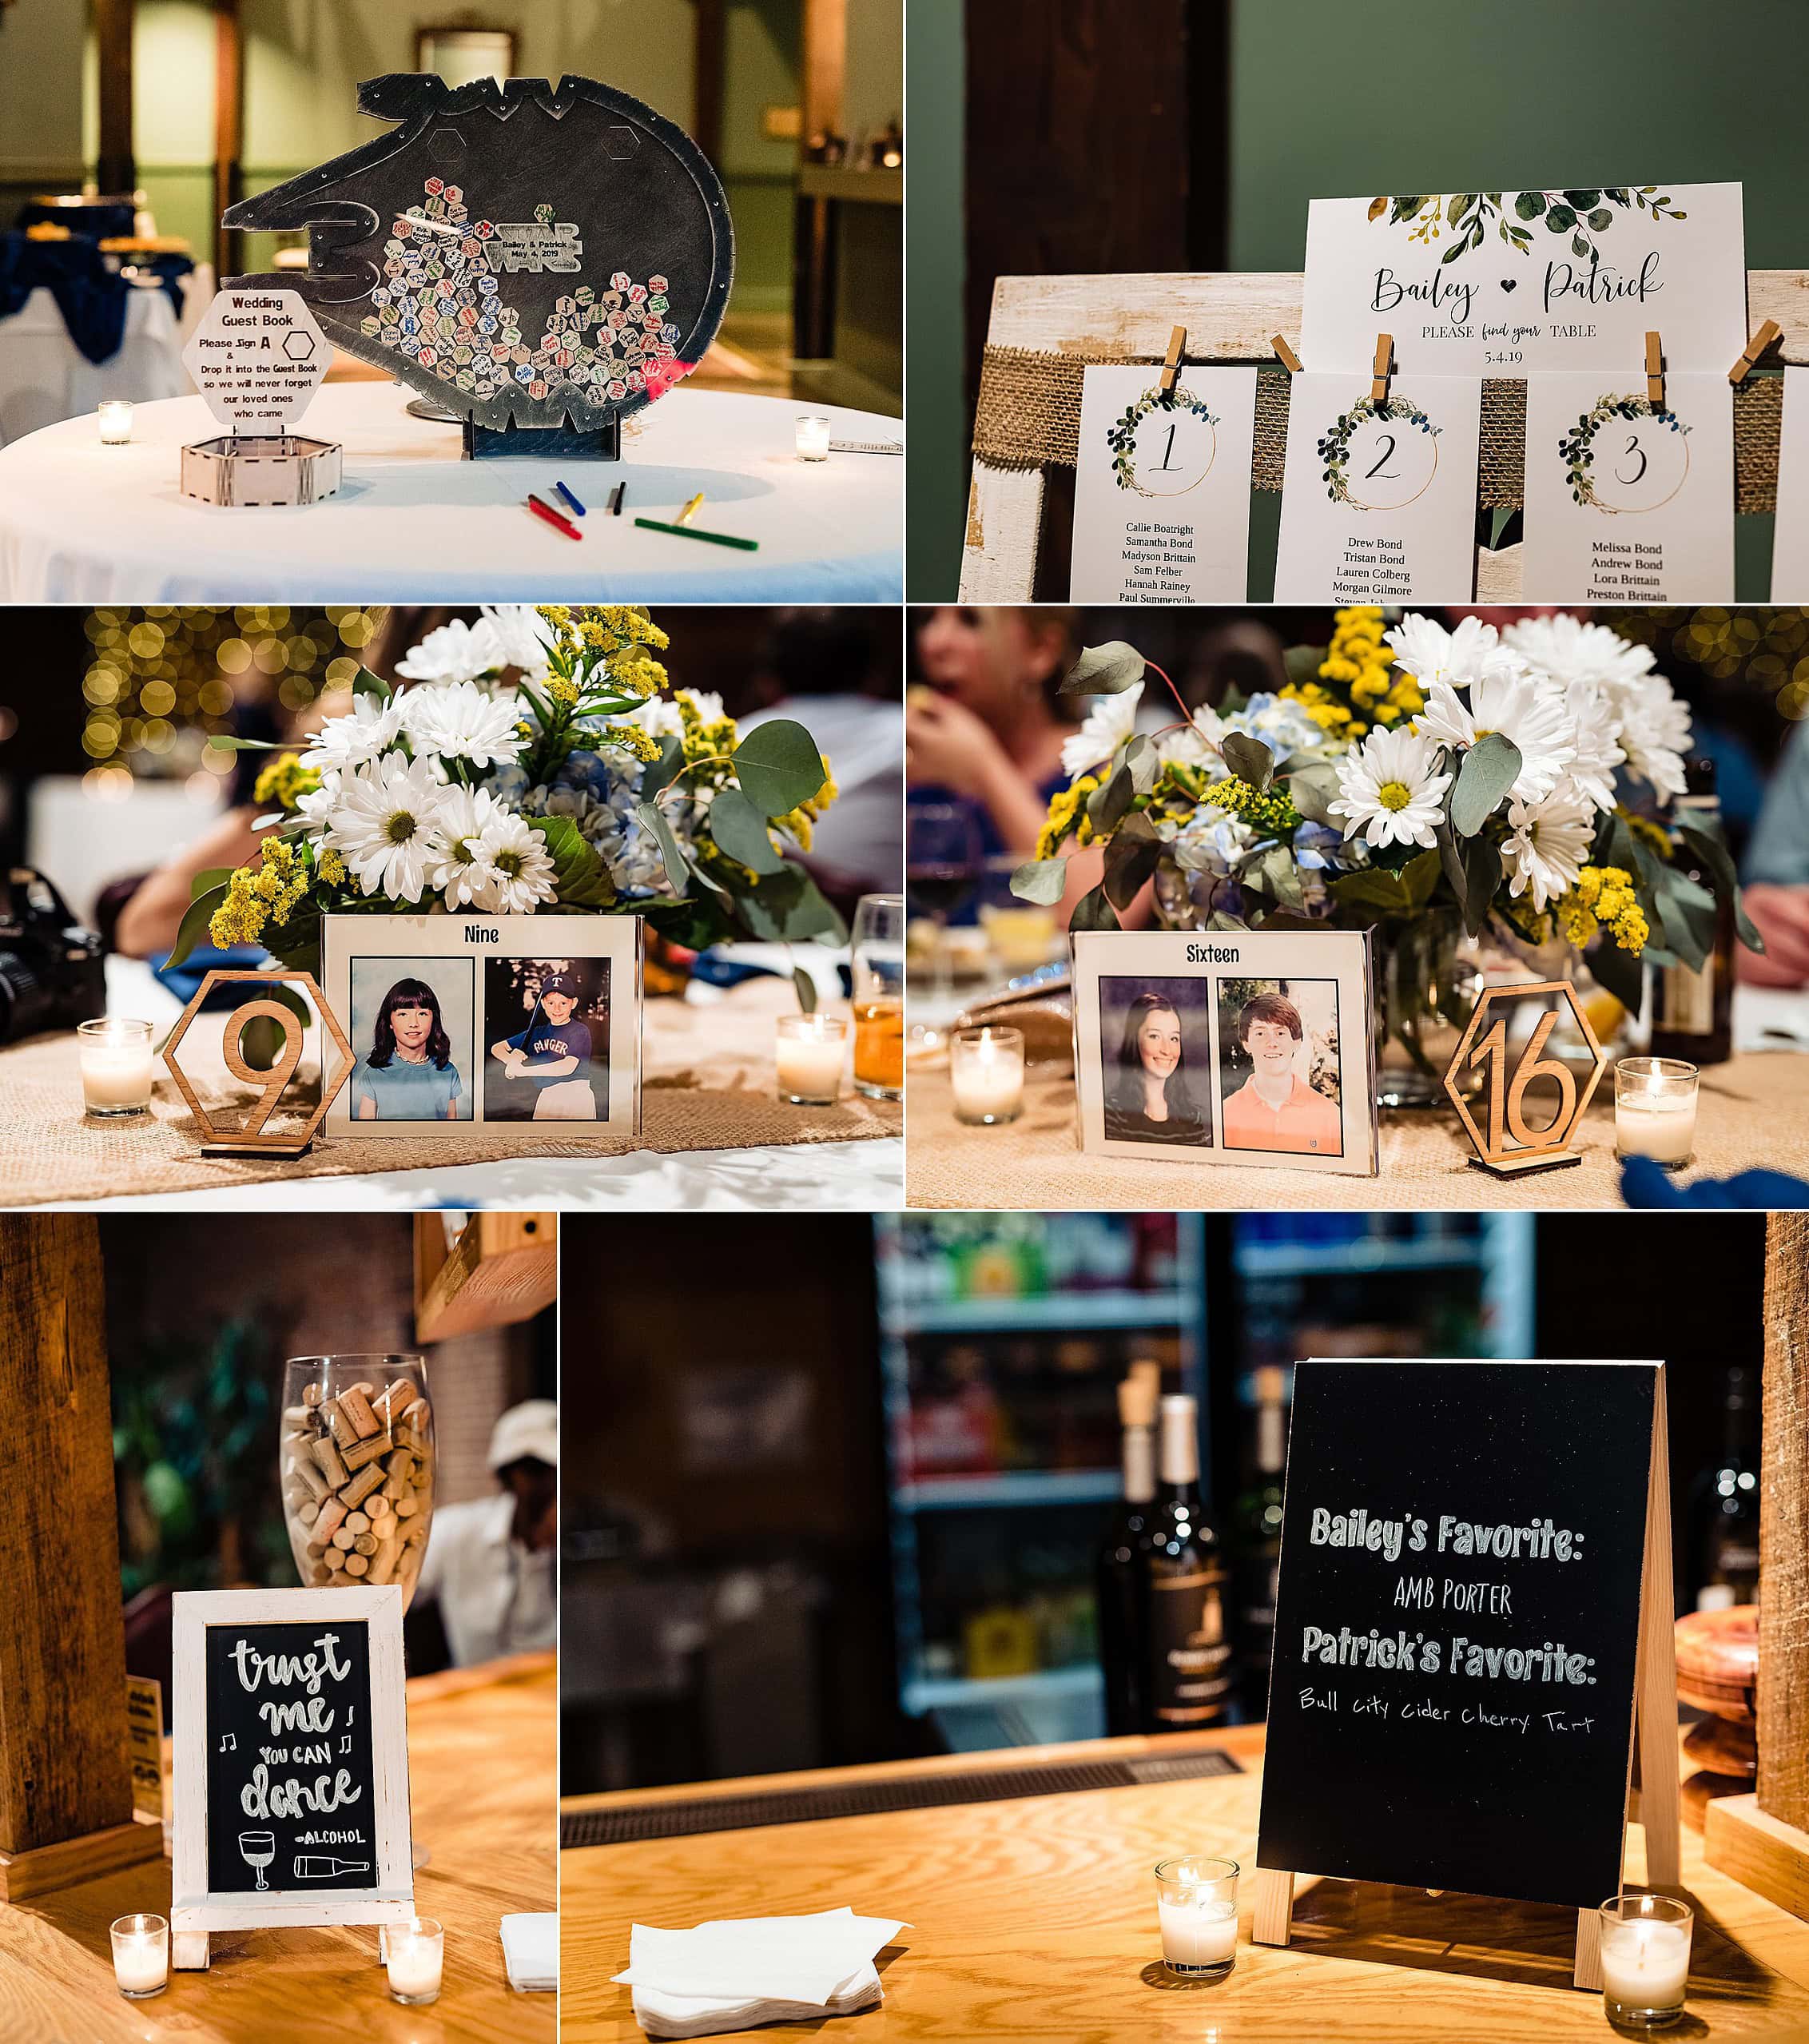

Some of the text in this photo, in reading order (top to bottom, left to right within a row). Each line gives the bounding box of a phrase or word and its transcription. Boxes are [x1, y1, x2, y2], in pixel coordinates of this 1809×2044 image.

[1370, 251, 1664, 324] Bailey Patrick
[232, 297, 283, 311] Wedding
[222, 315, 293, 326] Guest Book
[1421, 323, 1596, 344] PLEASE find your TABLE
[199, 336, 271, 349] Please Sign A
[1484, 350, 1523, 364] 5.4.19
[201, 365, 222, 376] Drop
[273, 364, 295, 373] Guest
[298, 364, 317, 373] Book
[284, 379, 312, 389] forget
[242, 394, 268, 404] loved
[234, 409, 253, 418] who
[1148, 424, 1183, 472] 1
[1365, 435, 1401, 479] 2
[1615, 435, 1647, 484] 3
[1126, 523, 1194, 536] Callie Boatright
[1125, 536, 1193, 549] Samantha Bond
[1348, 537, 1402, 550] Drew Bond
[1592, 542, 1662, 554] Melissa Bond
[1121, 551, 1196, 563] Madyson Brittain
[1343, 551, 1405, 565] Tristan Bond
[1591, 558, 1663, 570] Andrew Bond
[1133, 565, 1183, 577] Sam Felber
[1336, 567, 1410, 583] Lauren Colberg
[1124, 579, 1191, 593] Hannah Rainey
[1594, 573, 1660, 586] Lora Brittain
[1332, 581, 1413, 595] Morgan Gilmore
[1586, 588, 1668, 602] Preston Brittain
[1119, 592, 1138, 603] Paul
[464, 925, 499, 944] Nine
[1186, 944, 1239, 964] Sixteen
[551, 976, 563, 987] T
[222, 999, 304, 1138] 9
[1467, 1009, 1577, 1154] 16
[1310, 1507, 1584, 1562] Bailey's Favorite:
[1394, 1576, 1512, 1614] AMB PORTER
[1302, 1626, 1597, 1684] Patrick's Favorite:
[227, 1633, 351, 1695] trust
[258, 1697, 335, 1736] me
[1298, 1687, 1337, 1712] Bull
[1541, 1712, 1595, 1734] Tart
[258, 1742, 331, 1764] YOU CAN
[241, 1764, 361, 1820] dance
